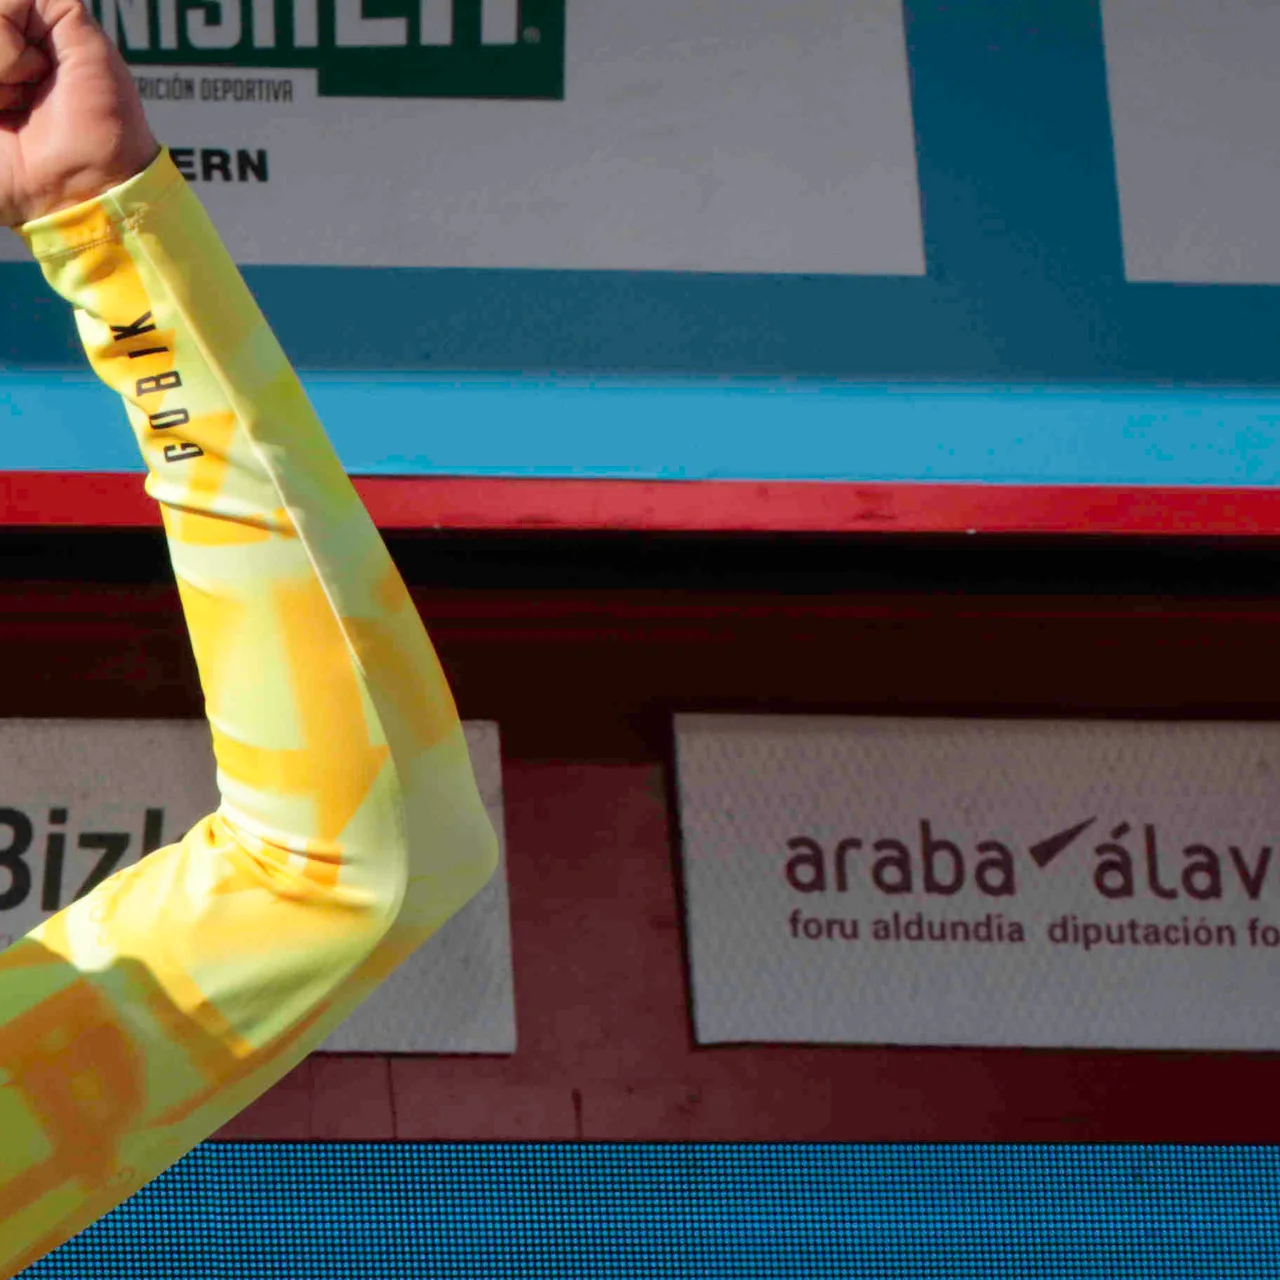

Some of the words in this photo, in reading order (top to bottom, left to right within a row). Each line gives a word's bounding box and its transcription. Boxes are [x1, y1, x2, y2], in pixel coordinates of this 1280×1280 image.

[200, 77, 293, 102] DEPORTIVA
[110, 310, 204, 464] GOBIK
[784, 818, 1016, 897] araba
[1093, 820, 1273, 901] álav
[790, 908, 860, 942] foru
[872, 911, 1026, 944] aldundia
[1047, 915, 1237, 951] diputación
